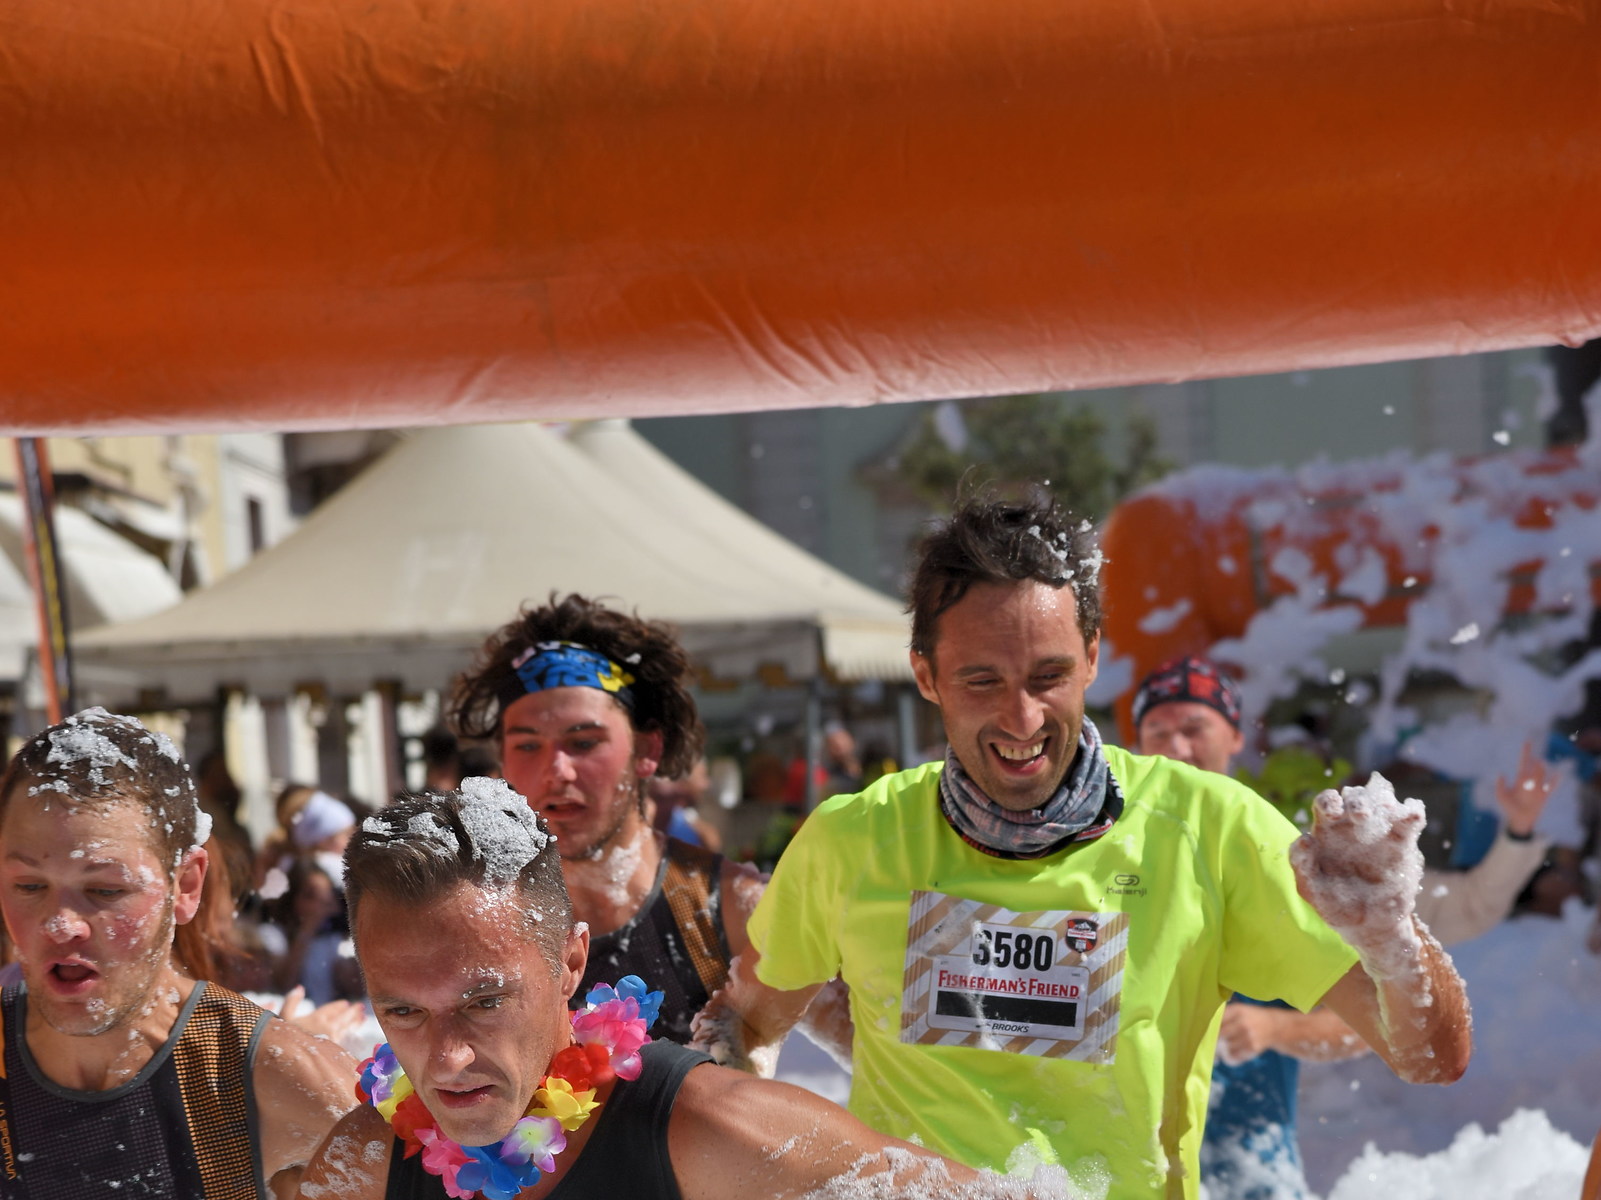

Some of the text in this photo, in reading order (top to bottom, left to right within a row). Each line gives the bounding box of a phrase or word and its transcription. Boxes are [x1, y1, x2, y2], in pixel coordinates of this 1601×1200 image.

[973, 929, 1054, 972] 3580
[938, 970, 1080, 998] FISHERMAN'S FRIEND
[992, 1022, 1030, 1033] BROOKS
[0, 1119, 17, 1180] SPORTIVA
